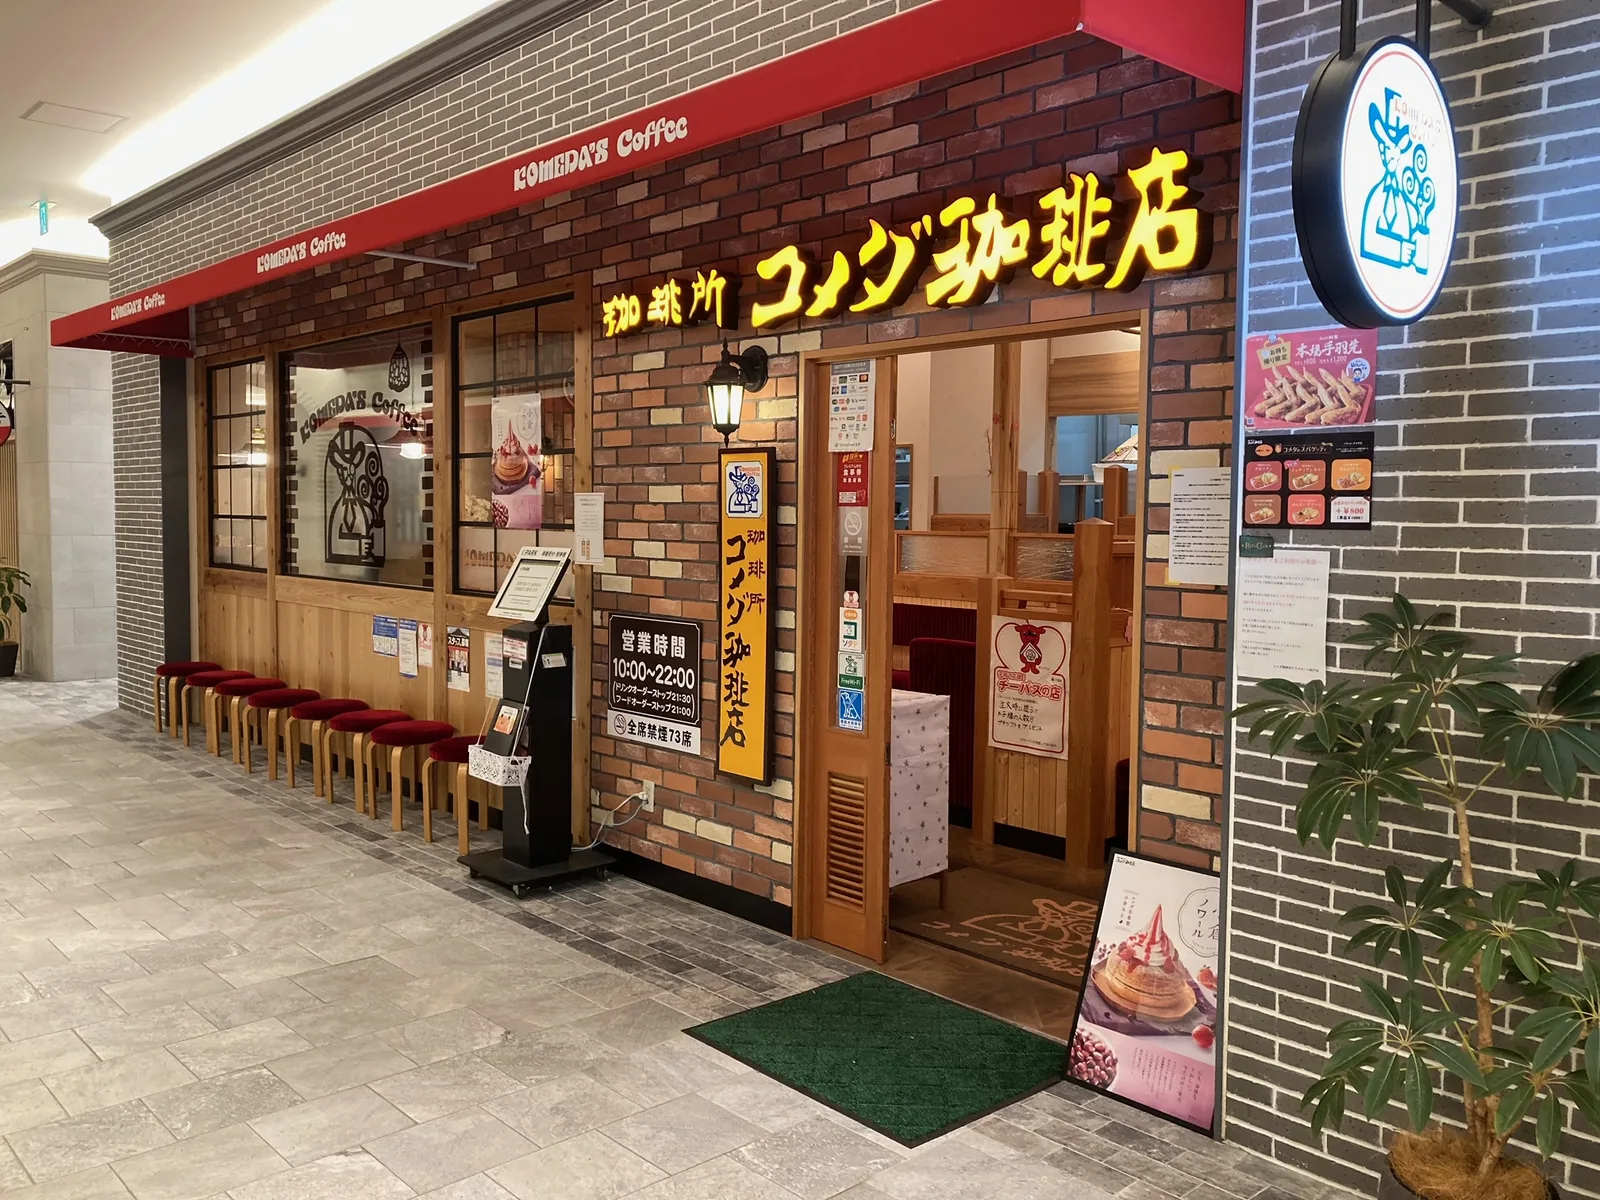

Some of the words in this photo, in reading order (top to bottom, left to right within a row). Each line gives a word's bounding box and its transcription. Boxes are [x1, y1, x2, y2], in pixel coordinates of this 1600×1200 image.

[513, 137, 609, 192] KOMEDA'S
[616, 116, 688, 158] Coffee
[256, 241, 307, 274] KOMEDA'S
[309, 231, 347, 257] Coffee
[750, 146, 1201, 328] コメダ珈琲店
[110, 298, 142, 321] KOMEDA'S
[143, 292, 166, 311] Coffee
[602, 268, 729, 338] 珈琲所
[299, 390, 367, 445] KOMEDA'S
[371, 391, 419, 436] Coffee
[746, 528, 766, 615] 珈琲所
[621, 629, 686, 660] 営業時間
[719, 534, 751, 749] コメダ珈琲店
[997, 678, 1062, 701] チーパスの店
[627, 719, 692, 748] 全席禁煙73席
[1191, 898, 1209, 938] ノワール
